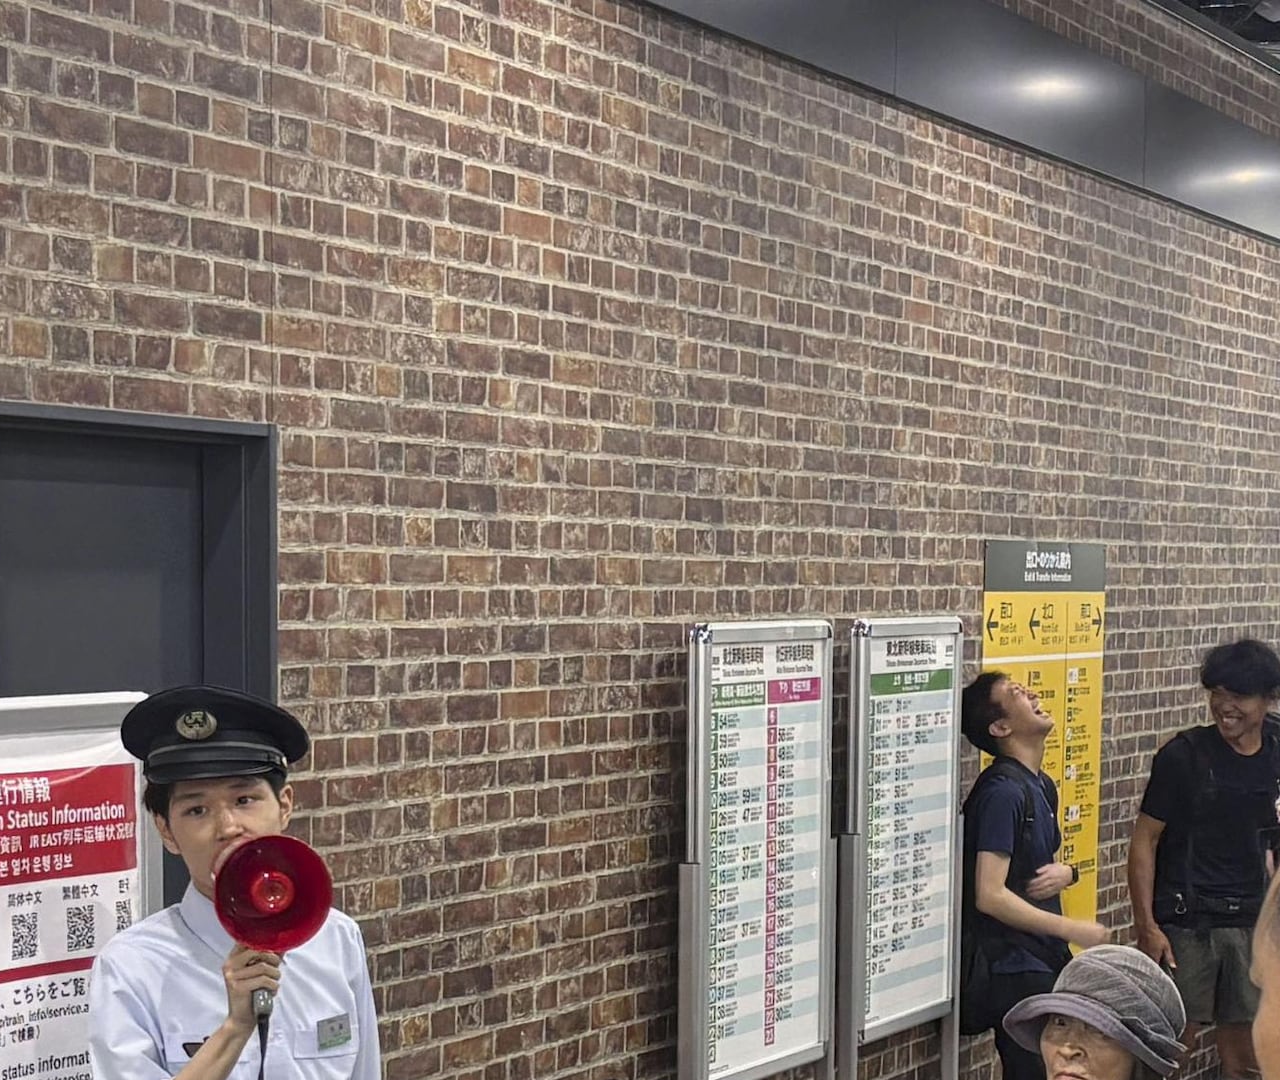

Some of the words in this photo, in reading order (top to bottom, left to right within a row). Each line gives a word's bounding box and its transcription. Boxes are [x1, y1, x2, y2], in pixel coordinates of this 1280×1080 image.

[7, 806, 49, 831] Status
[51, 801, 126, 826] Information
[28, 834, 39, 849] JR
